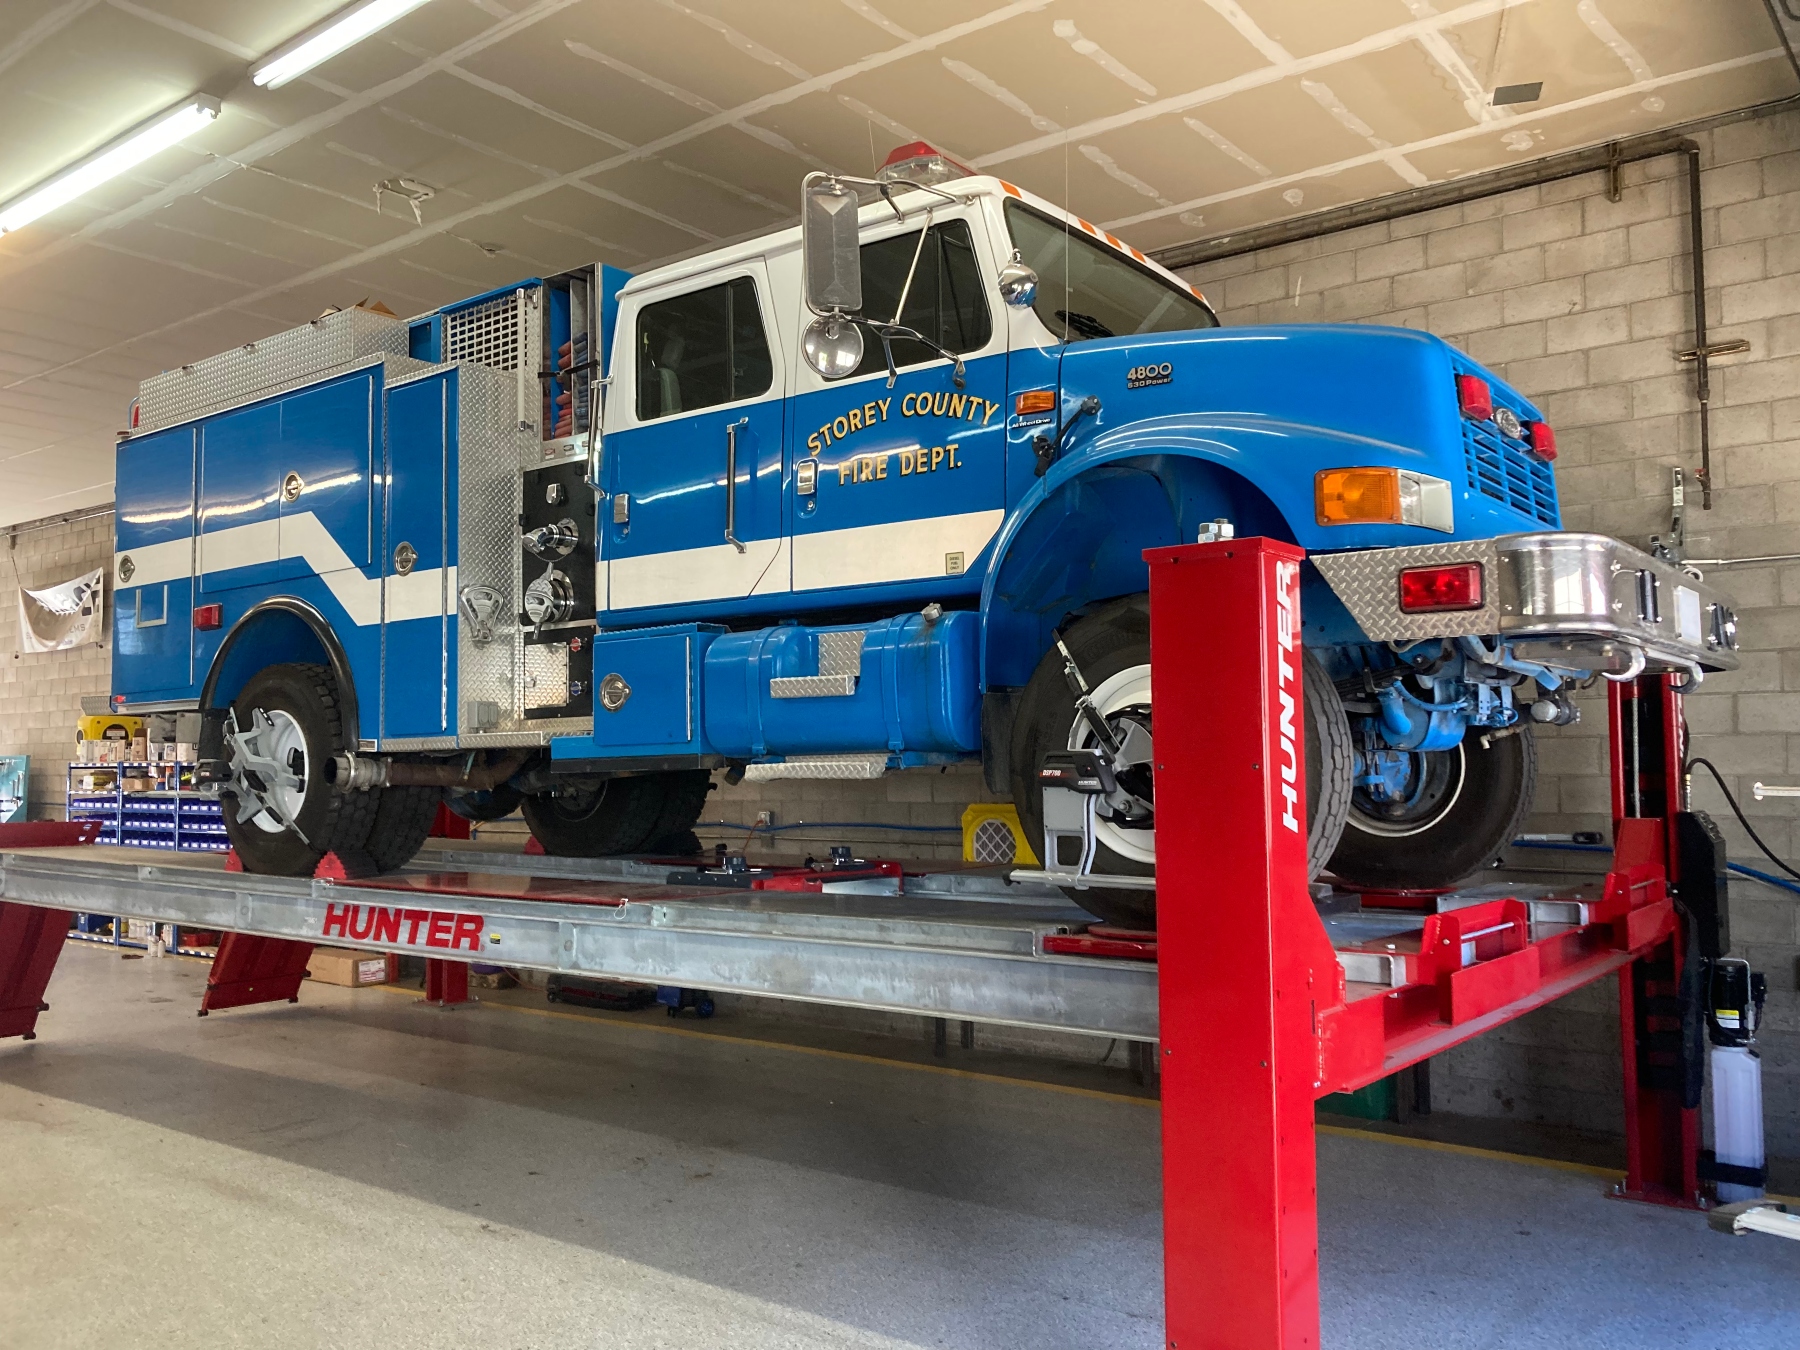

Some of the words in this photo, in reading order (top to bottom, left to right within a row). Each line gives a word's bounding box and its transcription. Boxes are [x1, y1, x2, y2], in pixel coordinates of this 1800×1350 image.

[1127, 362, 1172, 380] 4800
[807, 397, 892, 456] STOREY
[902, 391, 1000, 426] COUNTY
[838, 455, 888, 485] FIRE
[900, 444, 962, 476] DEPT.
[1275, 560, 1299, 834] HUNTER
[322, 903, 485, 951] HUNTER
